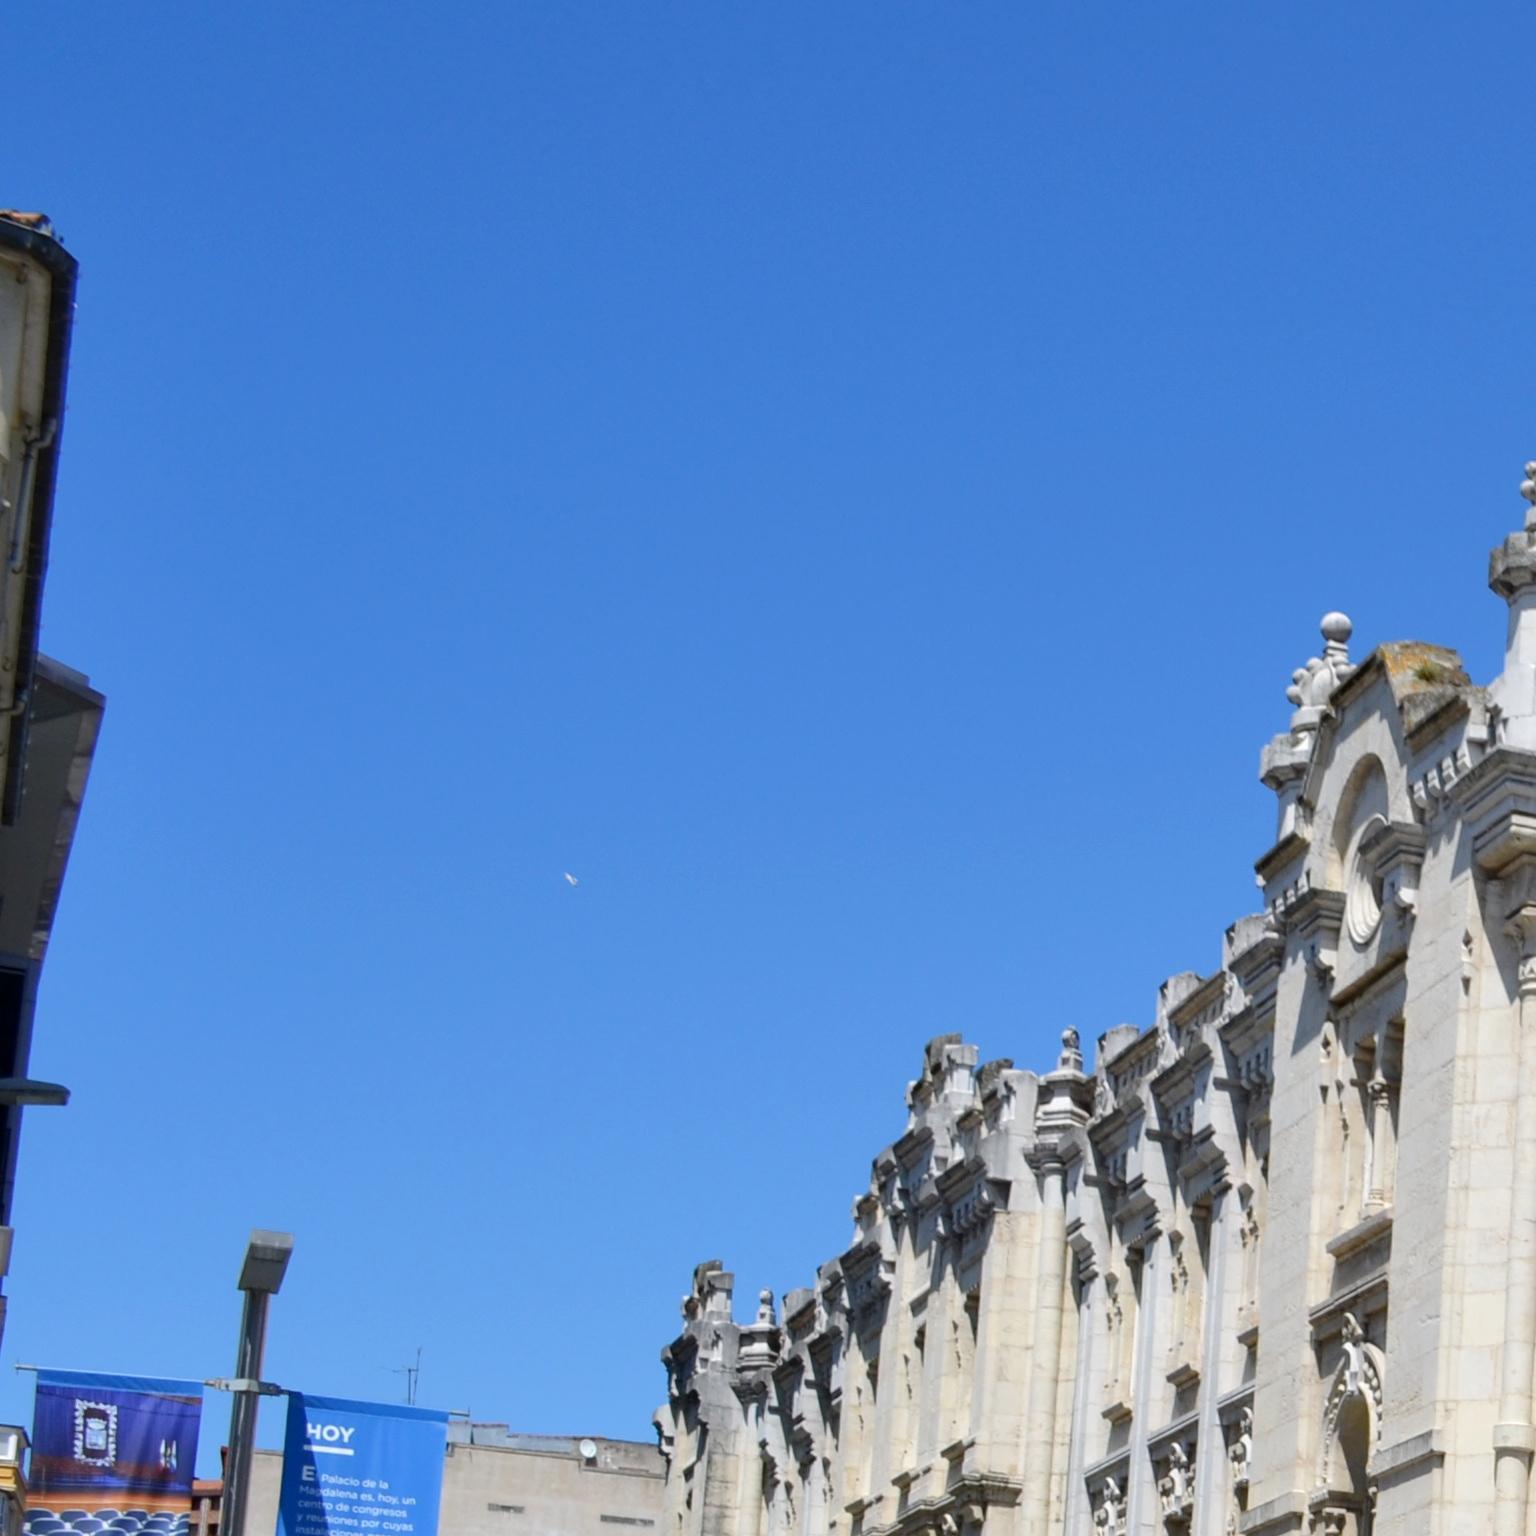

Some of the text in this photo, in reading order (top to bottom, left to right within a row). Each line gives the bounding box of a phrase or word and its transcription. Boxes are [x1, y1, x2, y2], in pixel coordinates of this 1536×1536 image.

[306, 1422, 355, 1443] HOY
[321, 1473, 360, 1485] Palacio
[299, 1486, 358, 1498] Magdalena
[352, 1507, 408, 1517] congresos
[306, 1515, 358, 1525] reuniones
[382, 1523, 414, 1532] cuyas
